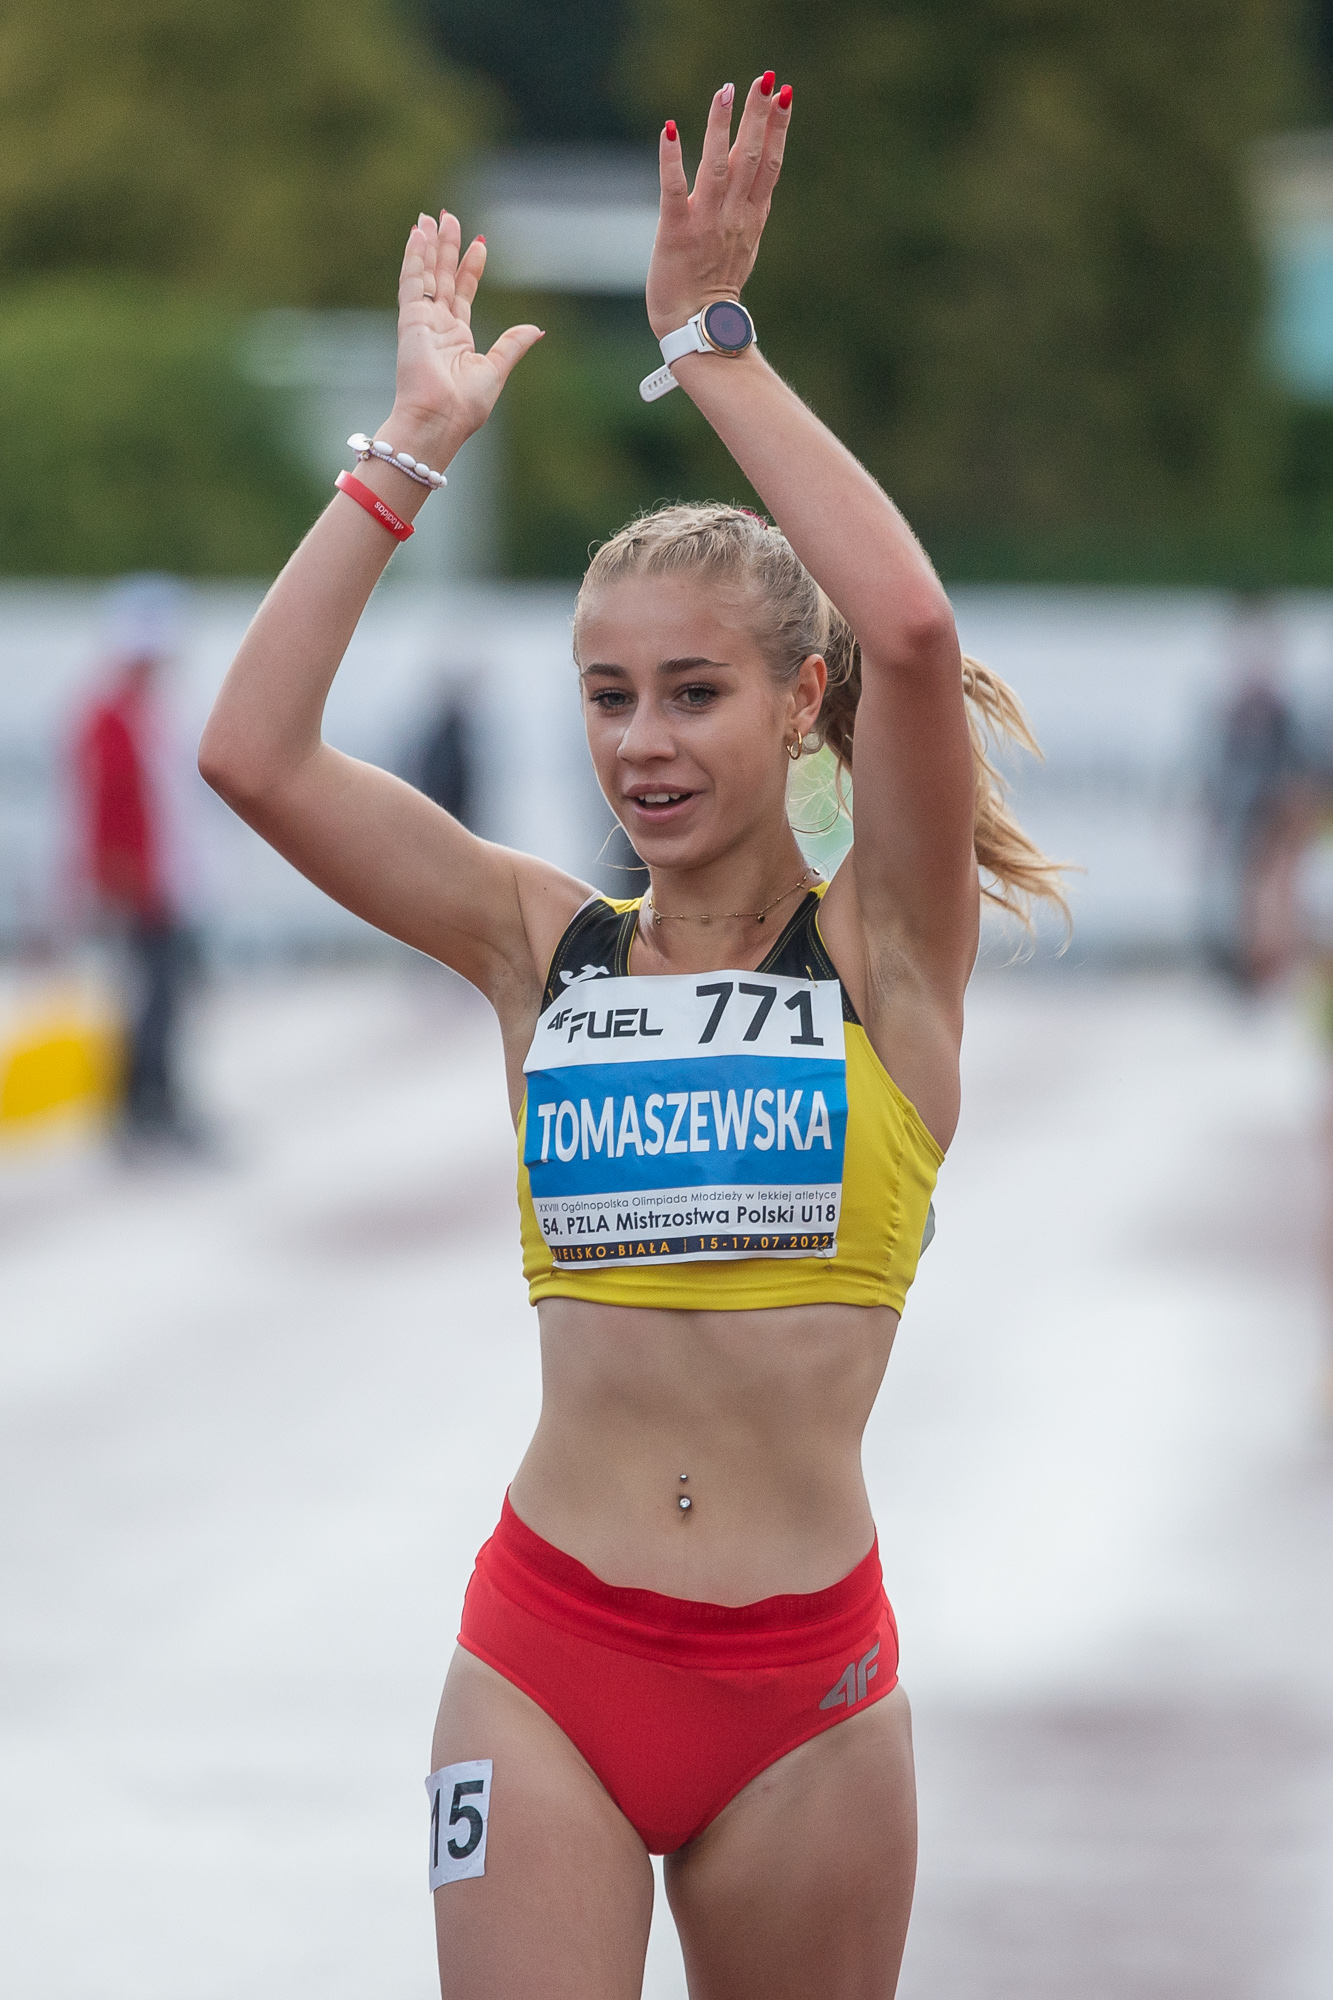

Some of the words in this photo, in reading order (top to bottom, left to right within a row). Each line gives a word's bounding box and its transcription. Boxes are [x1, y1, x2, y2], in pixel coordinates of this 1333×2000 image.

[374, 501, 398, 525] adidas
[567, 1008, 664, 1043] FUEL
[696, 981, 824, 1046] 771
[537, 1088, 832, 1163] TOMASZEWSKA
[538, 1203, 560, 1213] XXVIII
[561, 1199, 629, 1214] Ogólnopolska
[632, 1194, 688, 1207] Olimpiada
[690, 1190, 743, 1203] Młodzieży
[745, 1191, 755, 1200] w
[757, 1190, 792, 1202] lekkiej
[794, 1190, 837, 1201] atletyce
[543, 1217, 563, 1235] 54.
[567, 1214, 610, 1235] PZLA
[616, 1206, 730, 1231] Mistrzostwa
[737, 1205, 795, 1224] Polski
[801, 1204, 836, 1223] U18
[699, 1235, 830, 1250] 15-17.07.2022
[431, 1779, 485, 1869] 15
